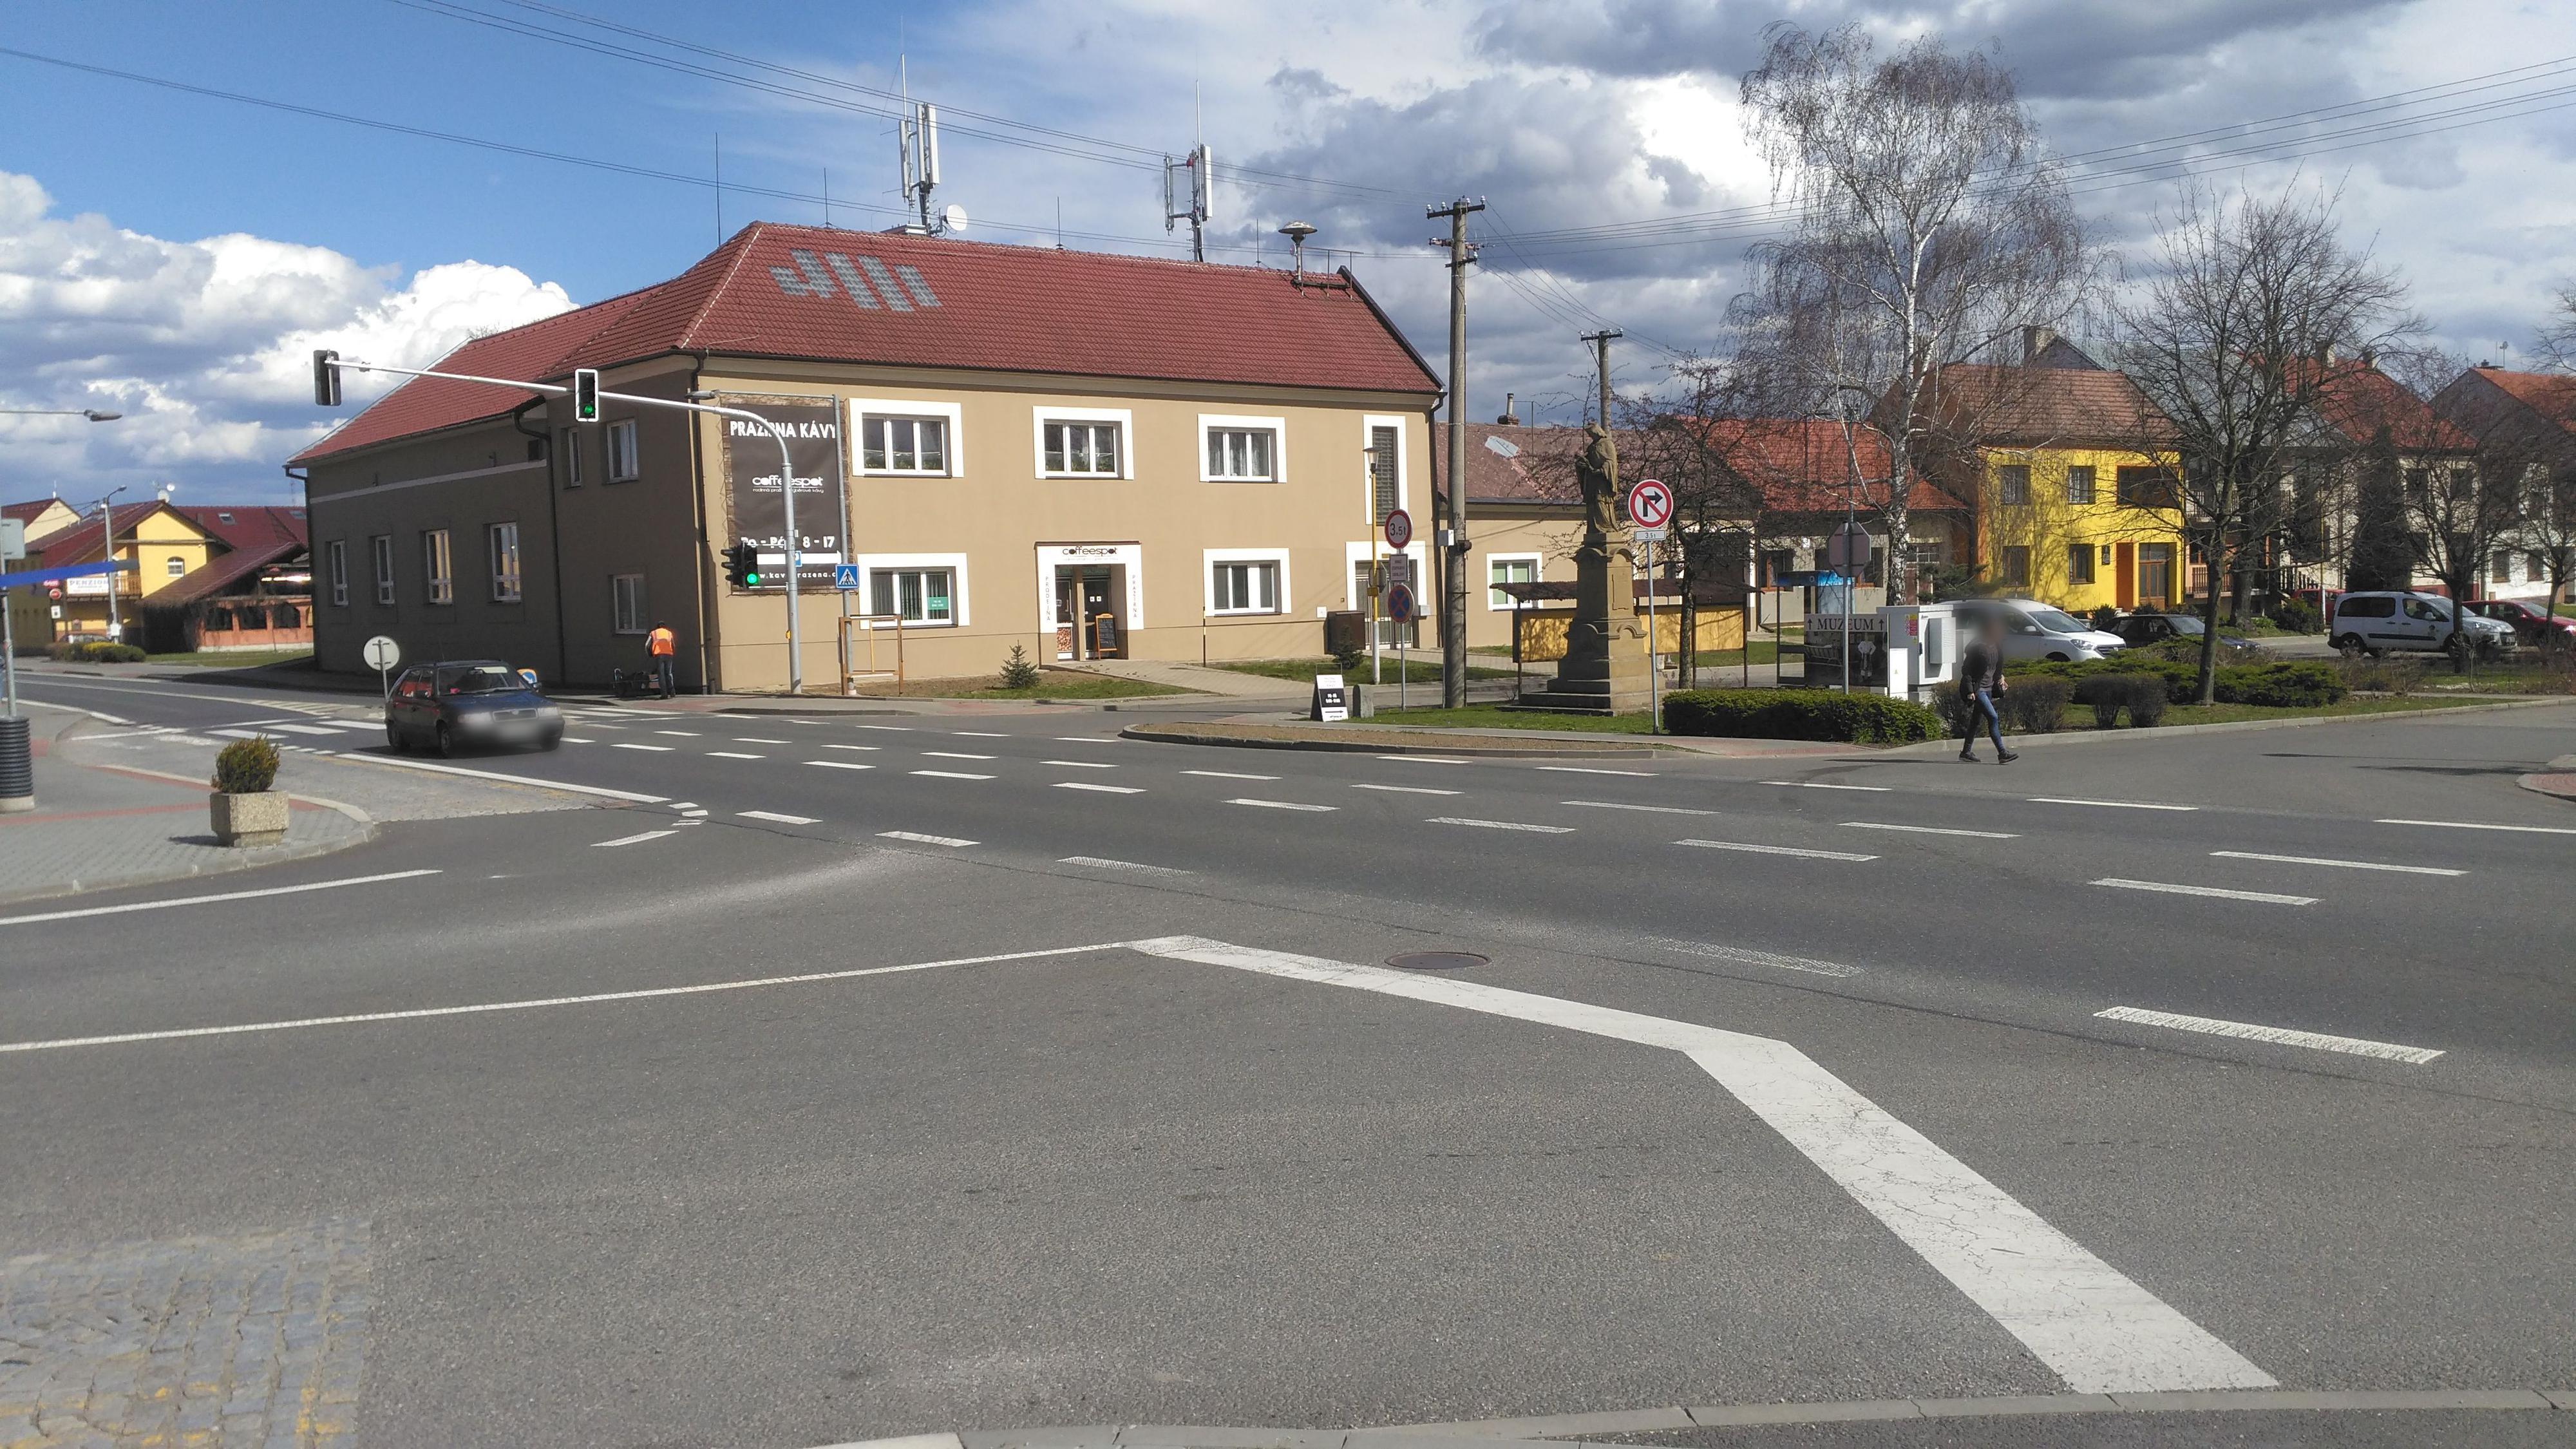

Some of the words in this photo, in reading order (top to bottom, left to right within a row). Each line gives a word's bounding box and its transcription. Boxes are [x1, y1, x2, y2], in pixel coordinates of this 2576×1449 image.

[800, 420, 835, 438] KÁVY
[802, 536, 810, 548] 8
[823, 536, 835, 548] 17
[1062, 545, 1117, 556] coffeespot
[1817, 618, 1874, 630] MUZEUM
